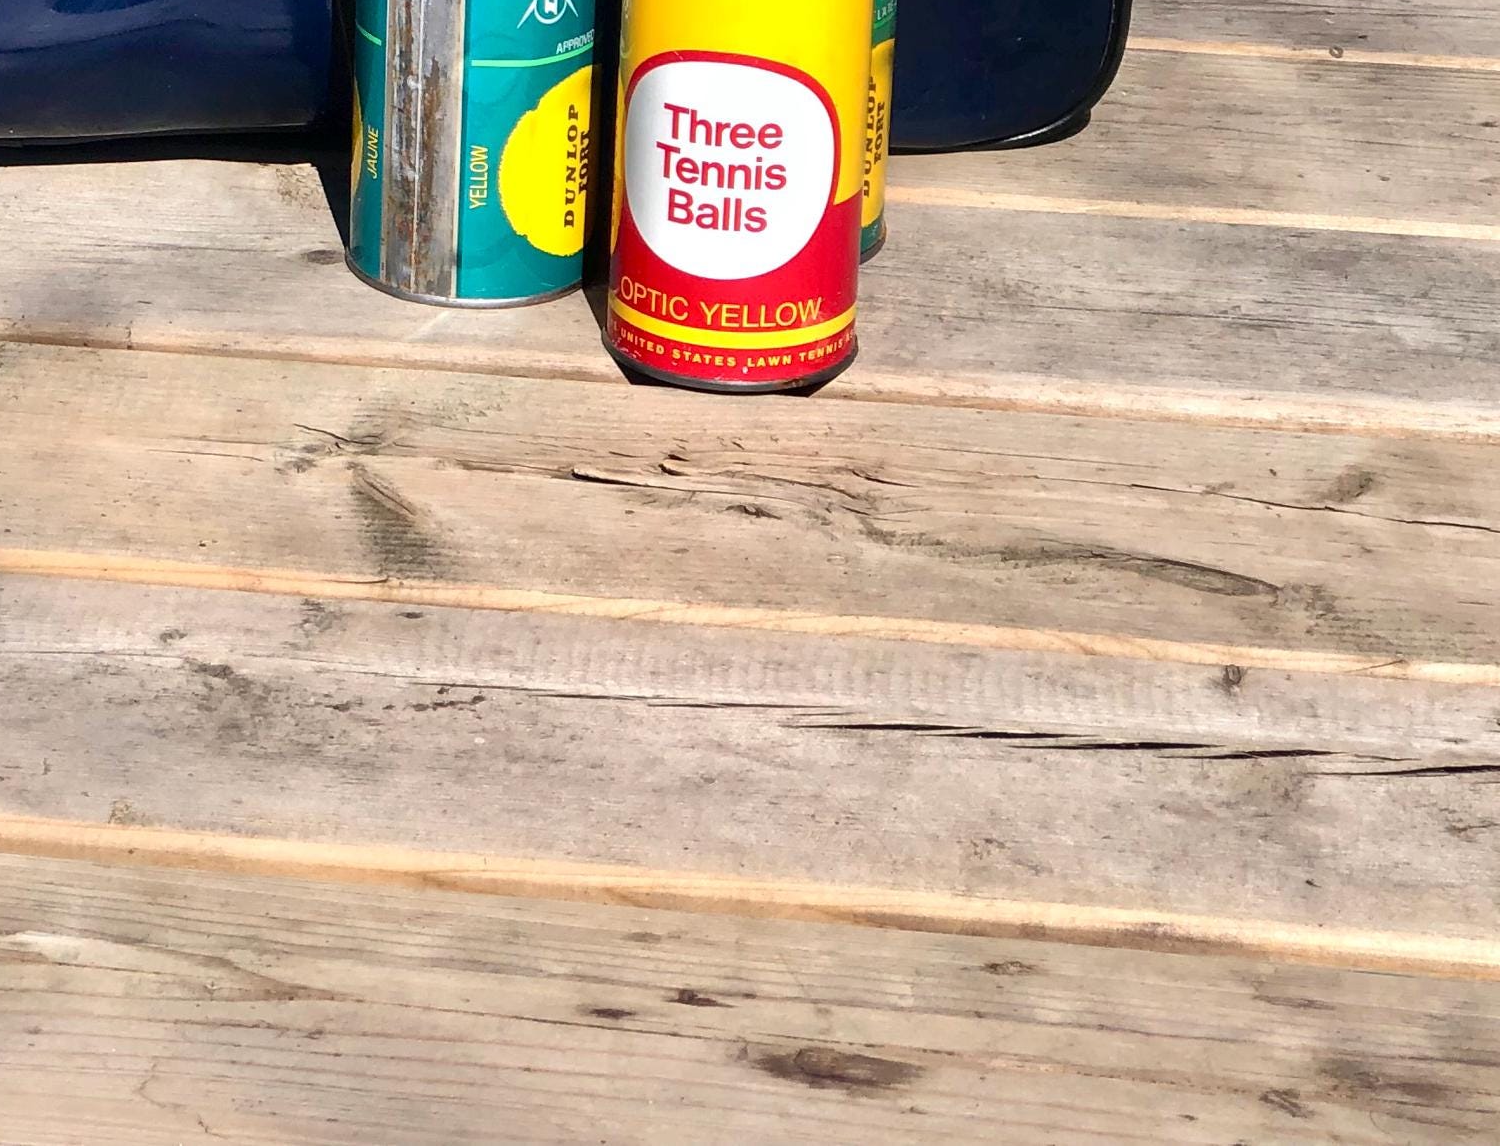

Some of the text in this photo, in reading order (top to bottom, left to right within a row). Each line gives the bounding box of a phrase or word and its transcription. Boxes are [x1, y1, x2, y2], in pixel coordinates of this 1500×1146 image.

[664, 102, 783, 149] Three
[366, 125, 379, 180] JAUNE
[469, 145, 489, 210] YELLOW
[564, 104, 579, 228] DUNLOP
[656, 141, 787, 190] Tennis
[668, 187, 767, 233] Balls
[621, 276, 822, 328] OPTIC YELLOW
[621, 327, 843, 368] UNITED STATES LAWN TENNIS
